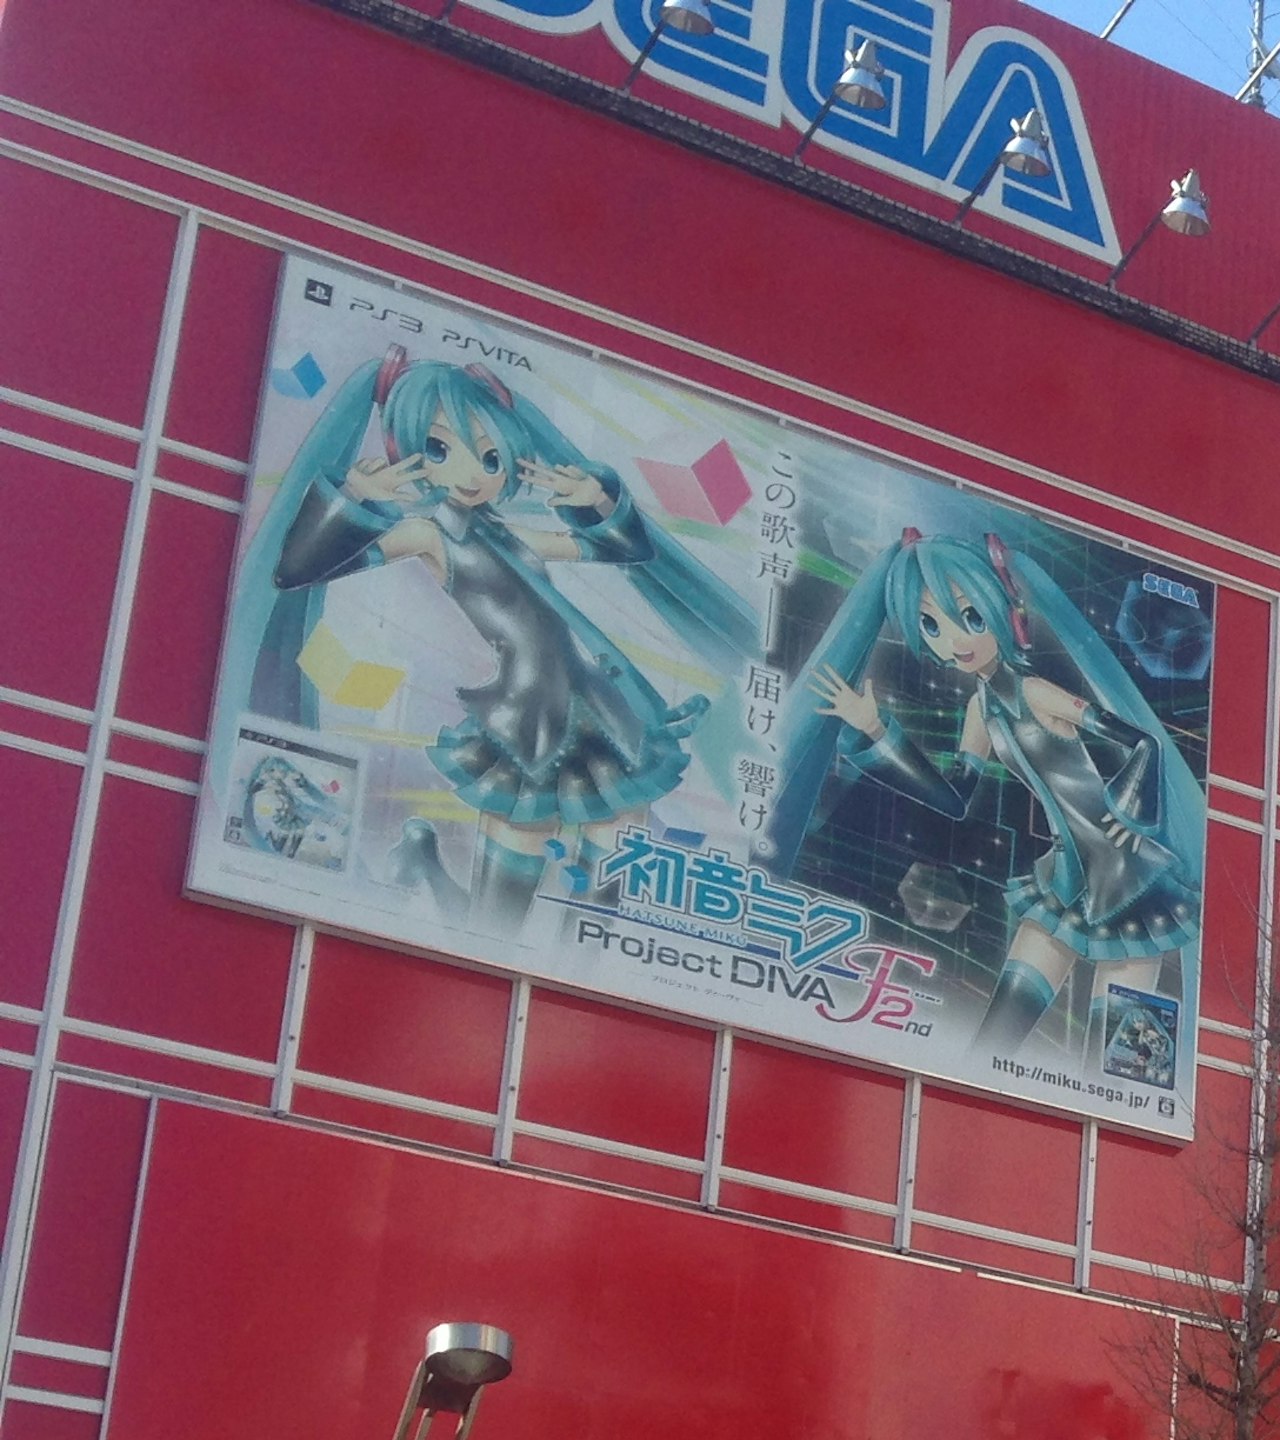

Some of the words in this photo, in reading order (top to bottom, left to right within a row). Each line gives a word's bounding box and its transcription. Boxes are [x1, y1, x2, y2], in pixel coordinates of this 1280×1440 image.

[349, 297, 424, 334] PS3
[1142, 572, 1200, 609] SEGA
[598, 823, 871, 975] 初音ミク
[618, 903, 700, 934] HATSUNE
[577, 919, 724, 977] Project
[730, 954, 837, 1010] DIVA
[992, 1055, 1151, 1109] http://miku.sega.jp/
